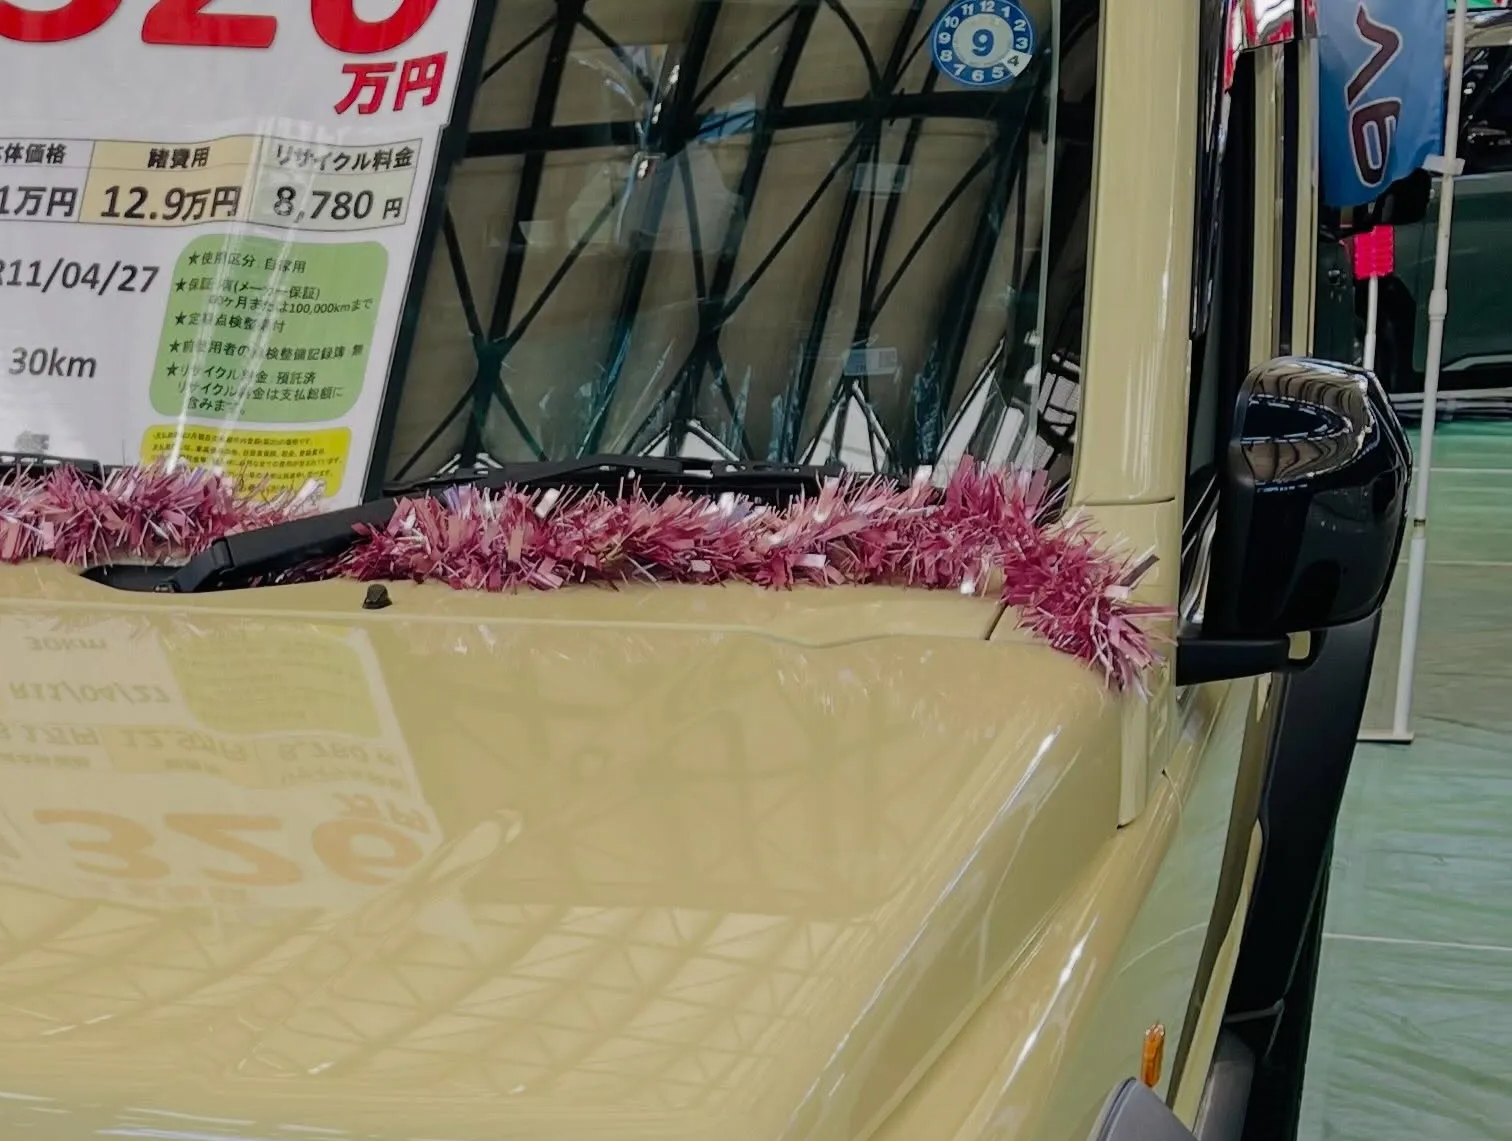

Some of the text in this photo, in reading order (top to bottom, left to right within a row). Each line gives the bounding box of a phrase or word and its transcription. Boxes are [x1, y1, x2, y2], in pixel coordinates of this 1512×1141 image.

[961, 3, 974, 16] 11
[979, 1, 996, 12] 12
[1001, 5, 1011, 18] 1
[944, 16, 960, 29] 10
[1013, 19, 1027, 32] 2
[938, 32, 951, 44] 9
[971, 28, 994, 57] 9
[1015, 37, 1029, 50] 3
[939, 49, 953, 62] 8
[1007, 55, 1019, 67] 4
[953, 63, 967, 76] 7
[971, 69, 985, 82] 6
[991, 66, 1005, 79] 5
[333, 50, 448, 115] 万円
[147, 146, 211, 168] 諸費用
[275, 144, 415, 173] リサイクル料金
[100, 184, 242, 222] 12.9万円
[274, 185, 402, 223] 8,780 円
[8, 347, 97, 378] 30km
